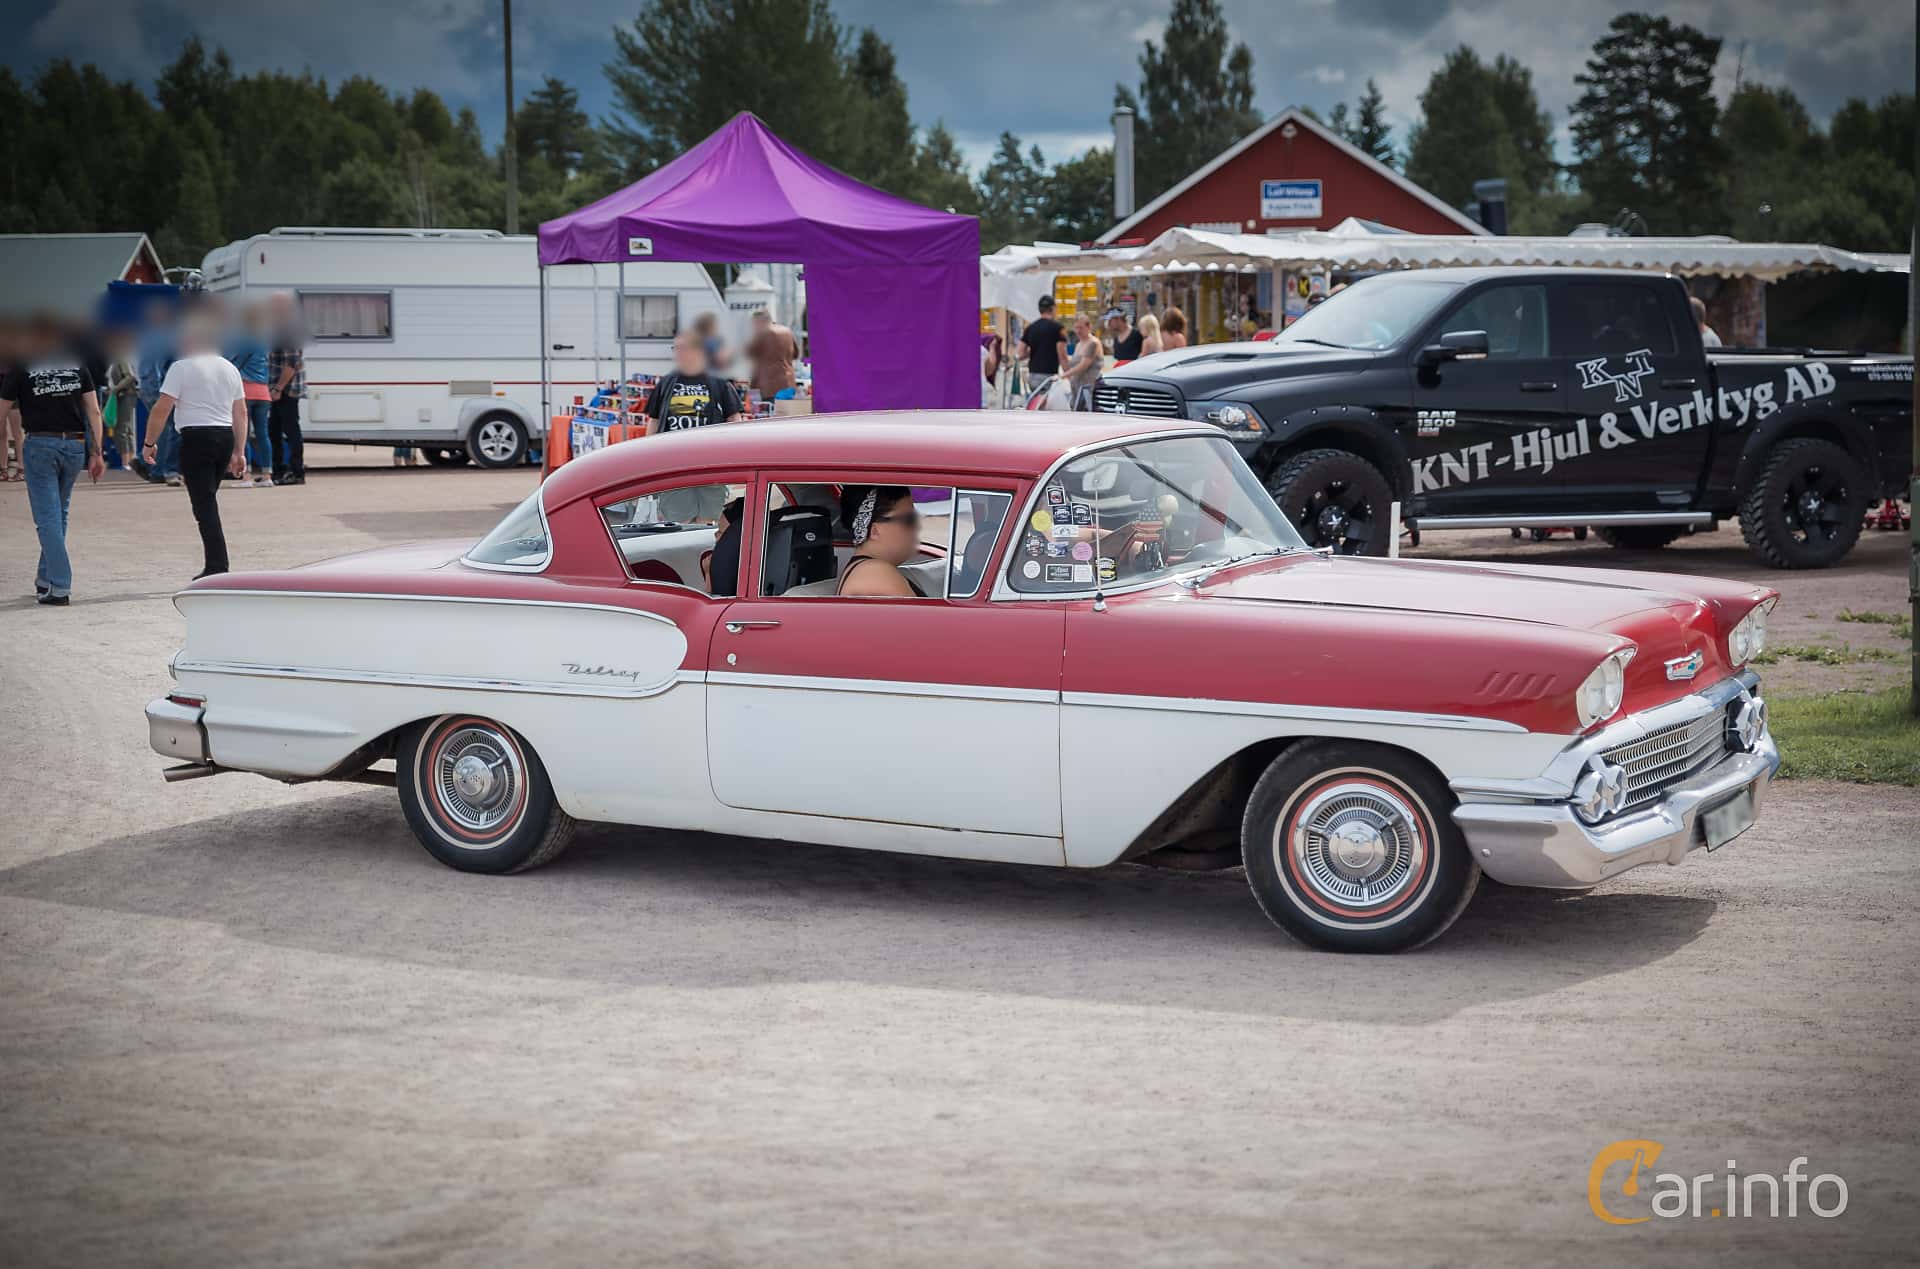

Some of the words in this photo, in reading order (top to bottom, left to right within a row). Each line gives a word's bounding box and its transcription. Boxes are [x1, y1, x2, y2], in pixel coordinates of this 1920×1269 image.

[1599, 412, 1636, 449] &
[1630, 382, 1778, 439] Verktyg
[1784, 361, 1836, 404] AB
[1417, 411, 1456, 419] RAM
[1417, 418, 1456, 427] 1500
